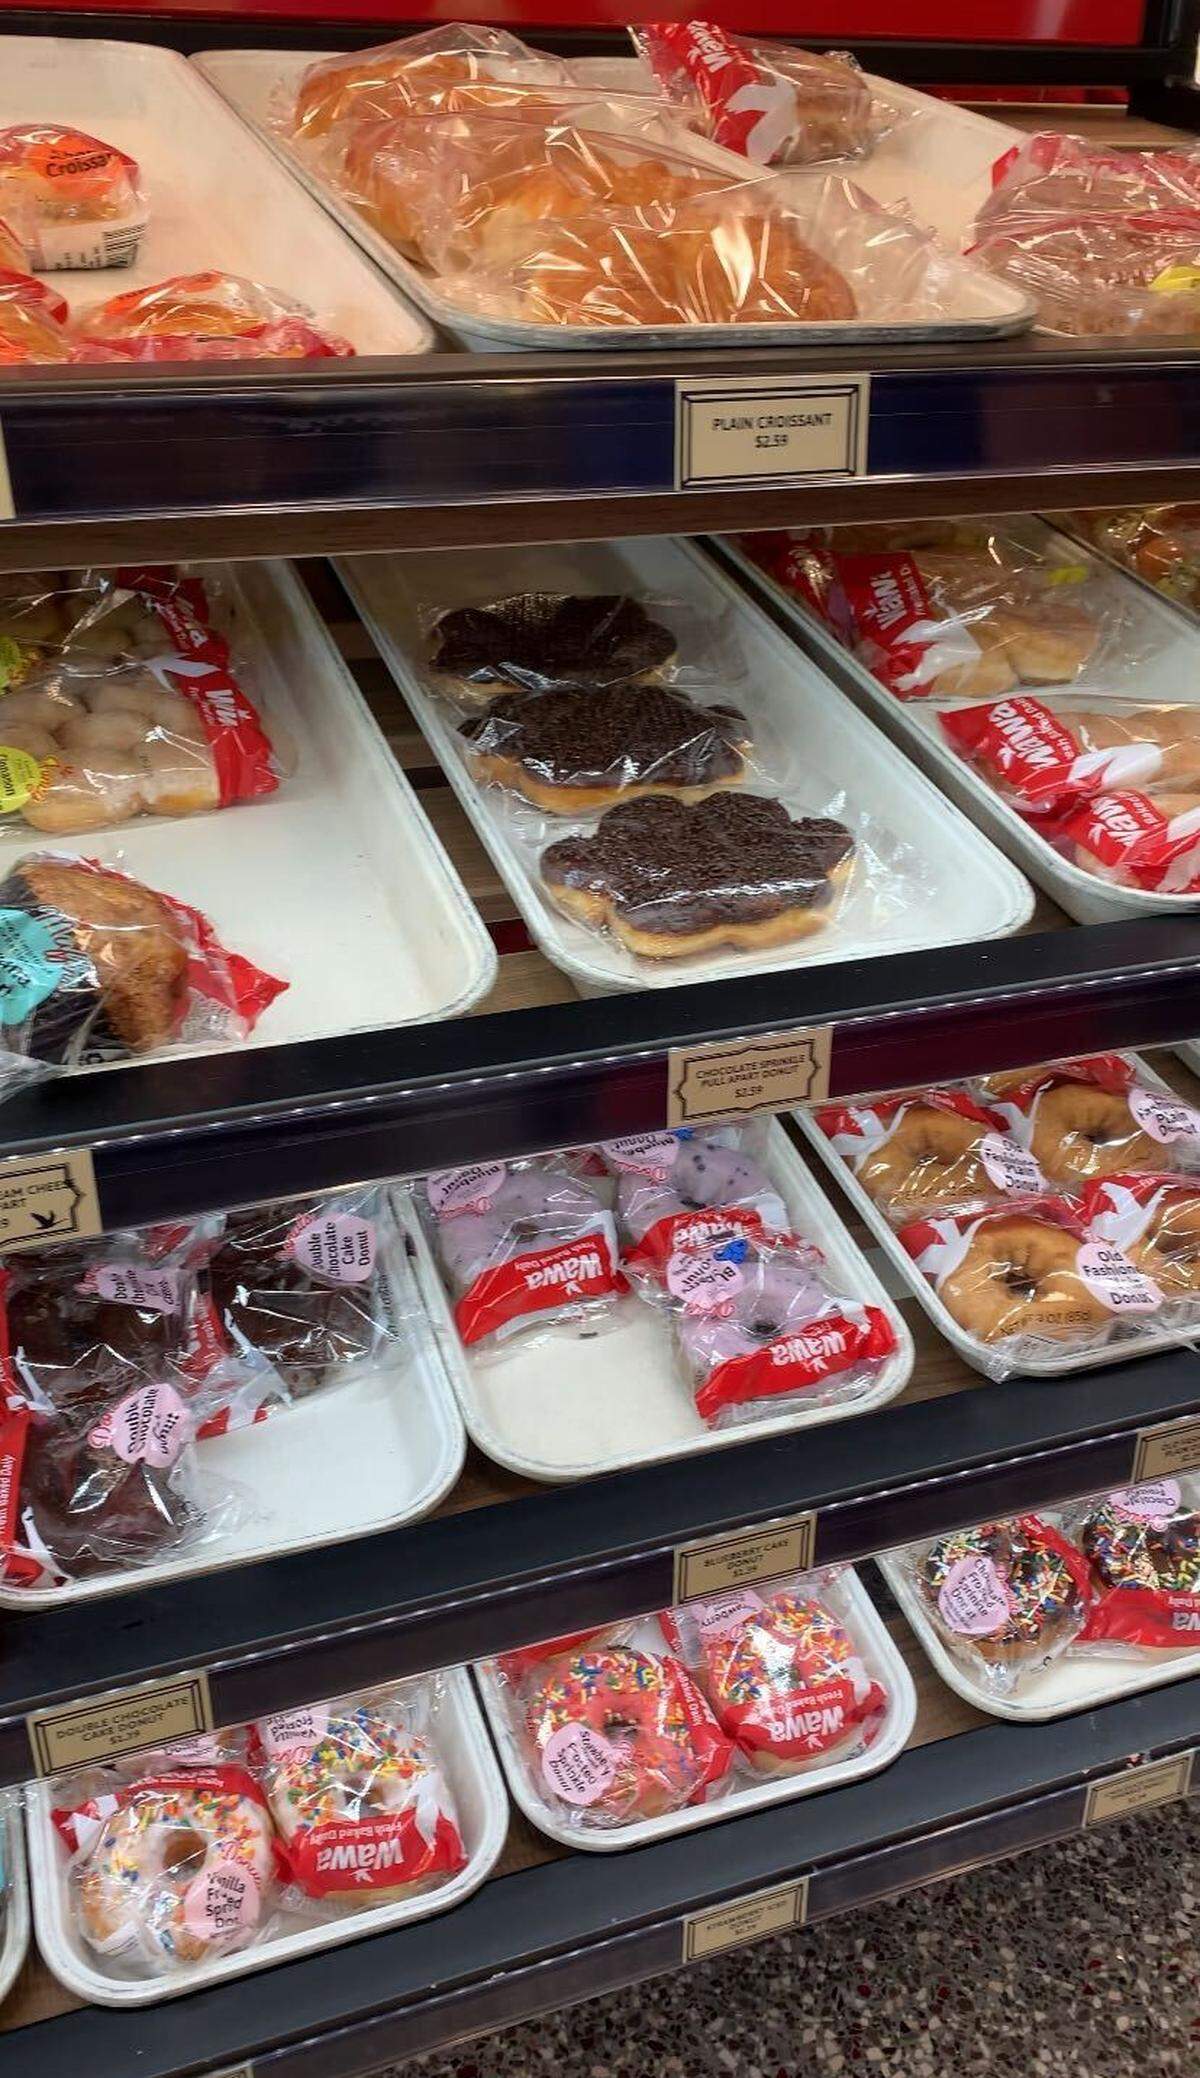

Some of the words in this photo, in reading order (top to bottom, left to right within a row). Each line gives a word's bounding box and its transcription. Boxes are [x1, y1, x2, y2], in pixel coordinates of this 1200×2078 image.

[712, 417, 754, 431] PLAIN
[759, 413, 832, 428] CROISSANT
[988, 699, 1058, 774] Wawa
[1089, 794, 1143, 848] Waw
[696, 1062, 757, 1079] CHOCOLATE
[760, 1054, 805, 1067] SPRINKLE
[729, 1072, 760, 1083] APART
[762, 1065, 799, 1078] DONUT
[341, 1236, 355, 1264] Cake
[356, 1230, 371, 1266] Donut
[1098, 1251, 1124, 1261] Old
[524, 1252, 602, 1291] Wawa
[1110, 1292, 1153, 1305] Donut
[768, 1330, 847, 1368] Wawa
[0, 1454, 17, 1476] Daily
[704, 1547, 762, 1567] BLUEBERRY
[763, 1539, 788, 1551] CAKE
[727, 1553, 763, 1569] DONUT
[816, 1689, 844, 1704] Fresh
[57, 1718, 108, 1739] DOUBLE
[114, 1696, 188, 1723] CHOCOLATE
[82, 1727, 114, 1742] CAKE
[118, 1712, 164, 1731] DONUT
[766, 1706, 844, 1743] Wawa
[309, 1830, 337, 1846] Daily
[338, 1826, 373, 1840] Baked
[374, 1821, 402, 1835] Fresh
[316, 1838, 405, 1872] Wawa
